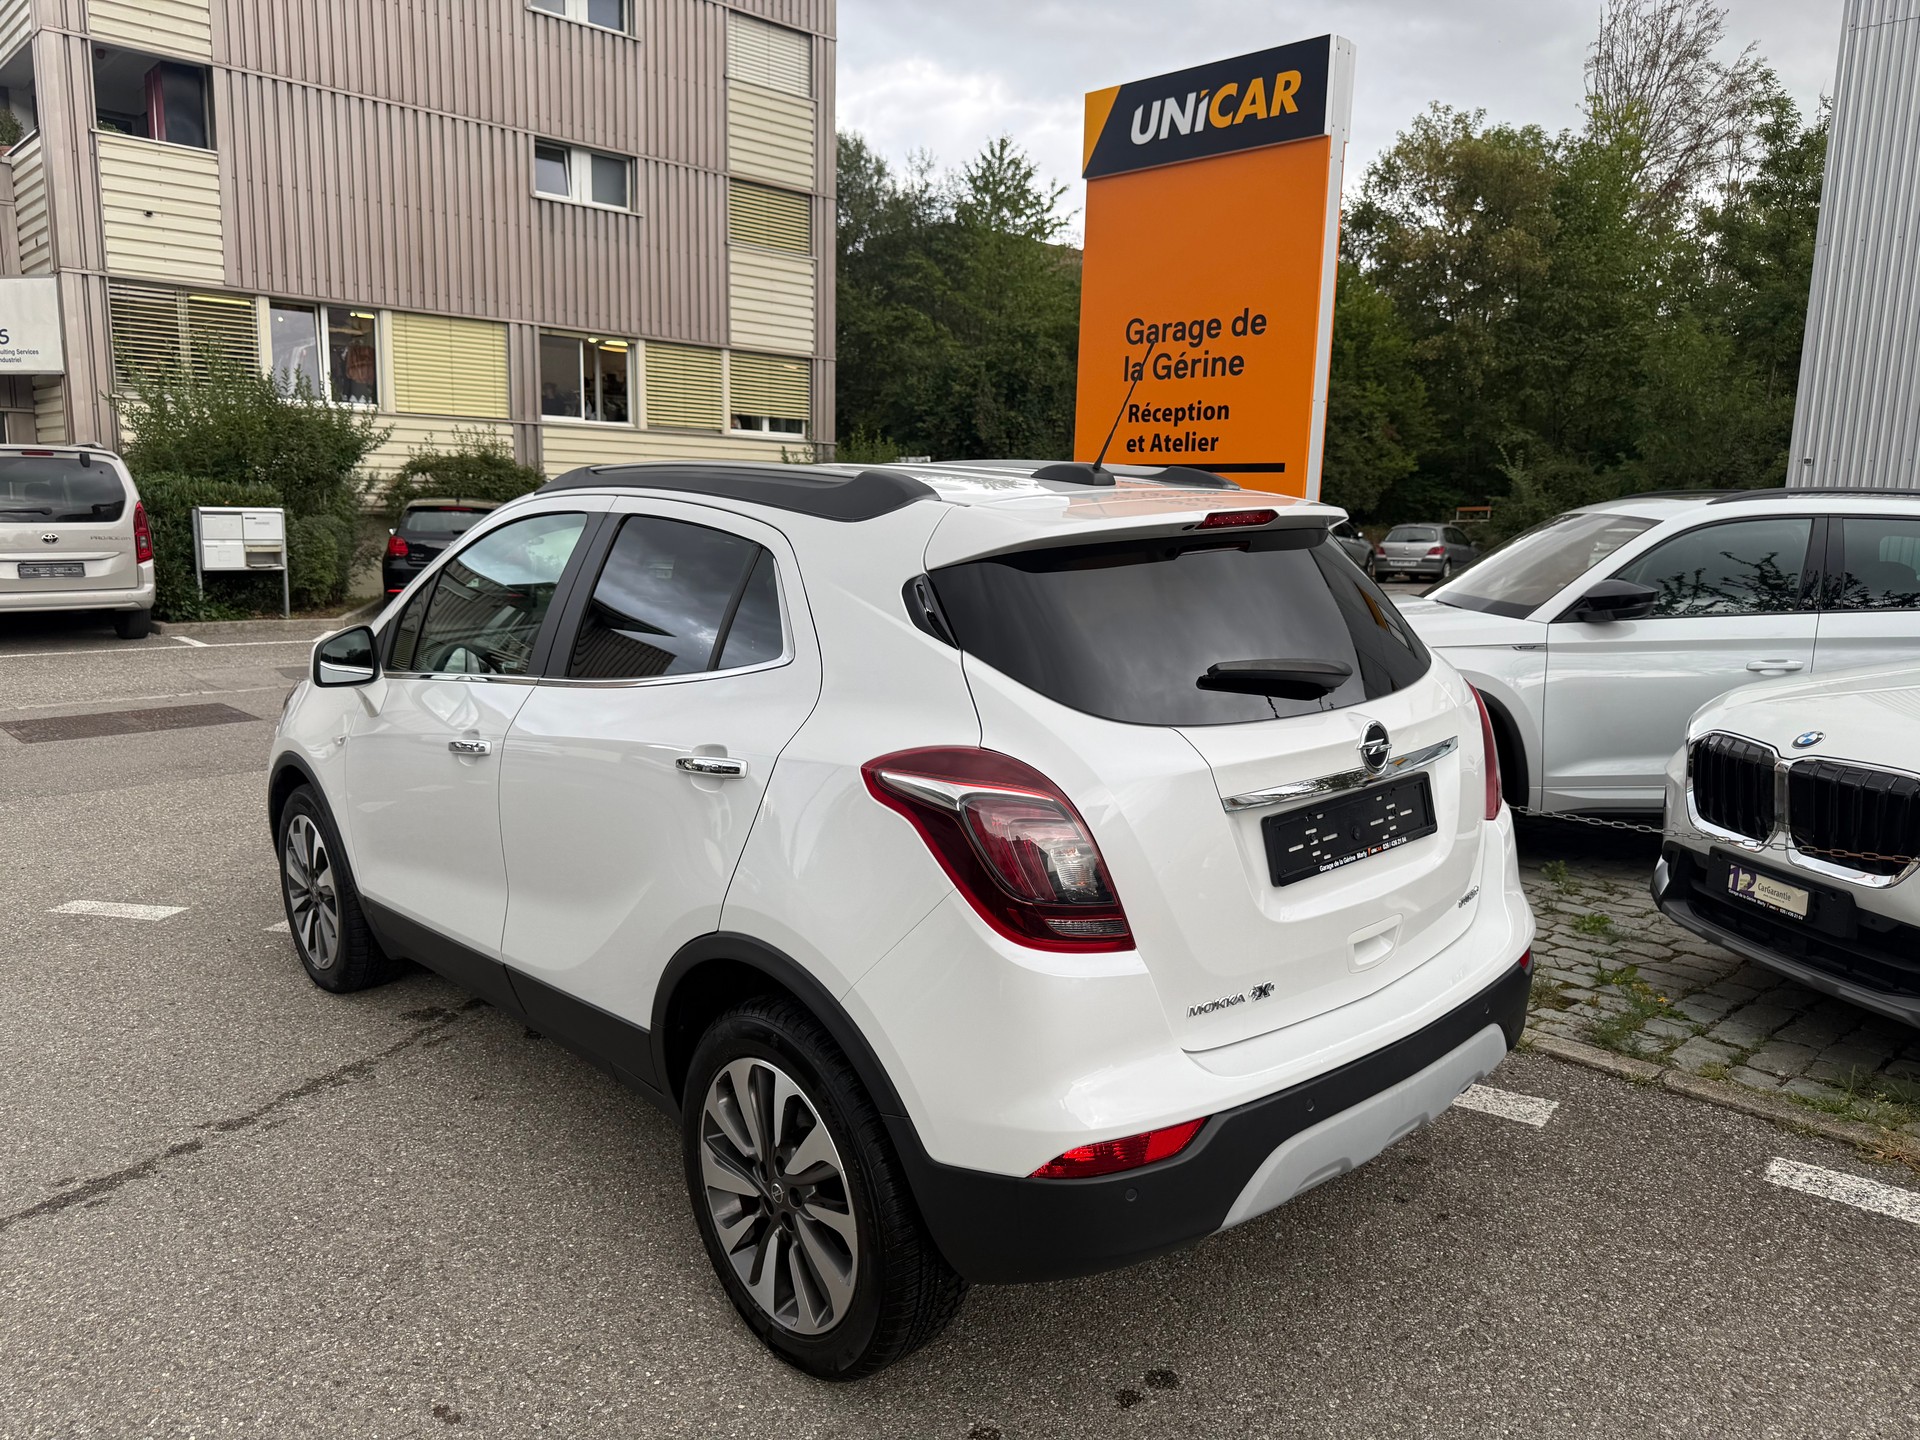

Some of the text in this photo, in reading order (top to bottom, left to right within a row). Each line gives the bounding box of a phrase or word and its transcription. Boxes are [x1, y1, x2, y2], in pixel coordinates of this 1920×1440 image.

[1125, 307, 1267, 348] Garage de
[1123, 350, 1245, 382] la Gérine
[1127, 400, 1230, 427] Réception
[1126, 431, 1219, 452] et Atelier
[1319, 862, 1334, 872] Garage
[1757, 882, 1792, 901] CarGarantie
[1186, 993, 1246, 1018] MOKKA
